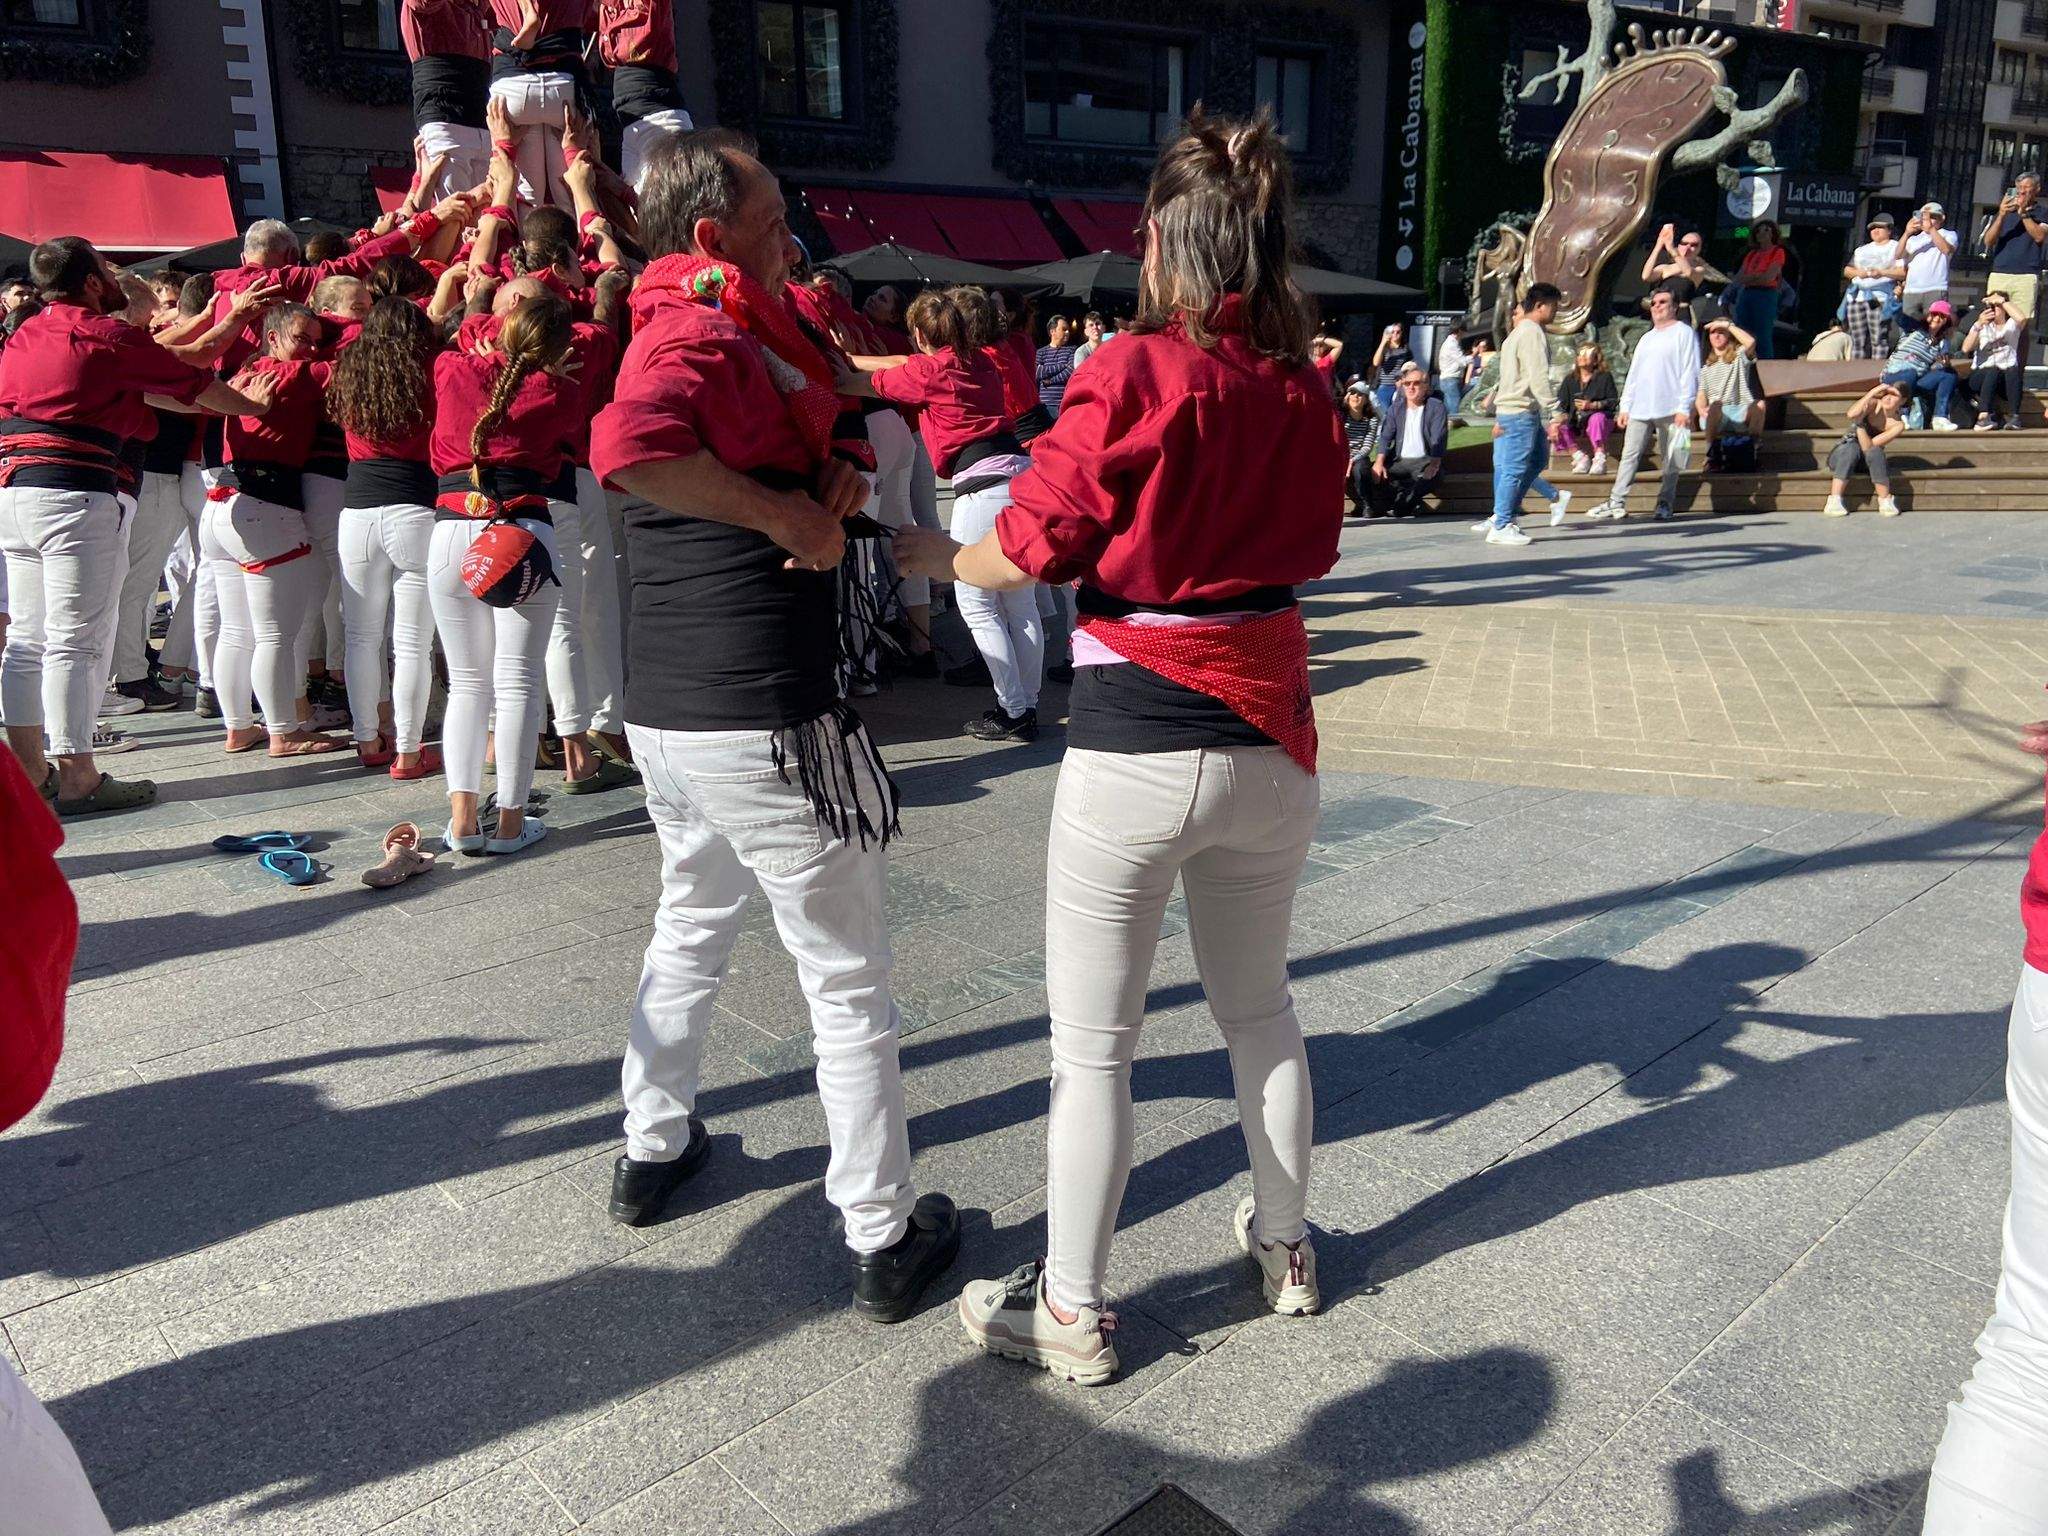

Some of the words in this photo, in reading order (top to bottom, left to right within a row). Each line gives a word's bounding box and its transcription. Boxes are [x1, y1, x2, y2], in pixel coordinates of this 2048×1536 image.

[1400, 53, 1424, 168] Cabana
[1399, 172, 1417, 210] La
[1787, 181, 1803, 201] La
[1805, 182, 1855, 205] Cabana
